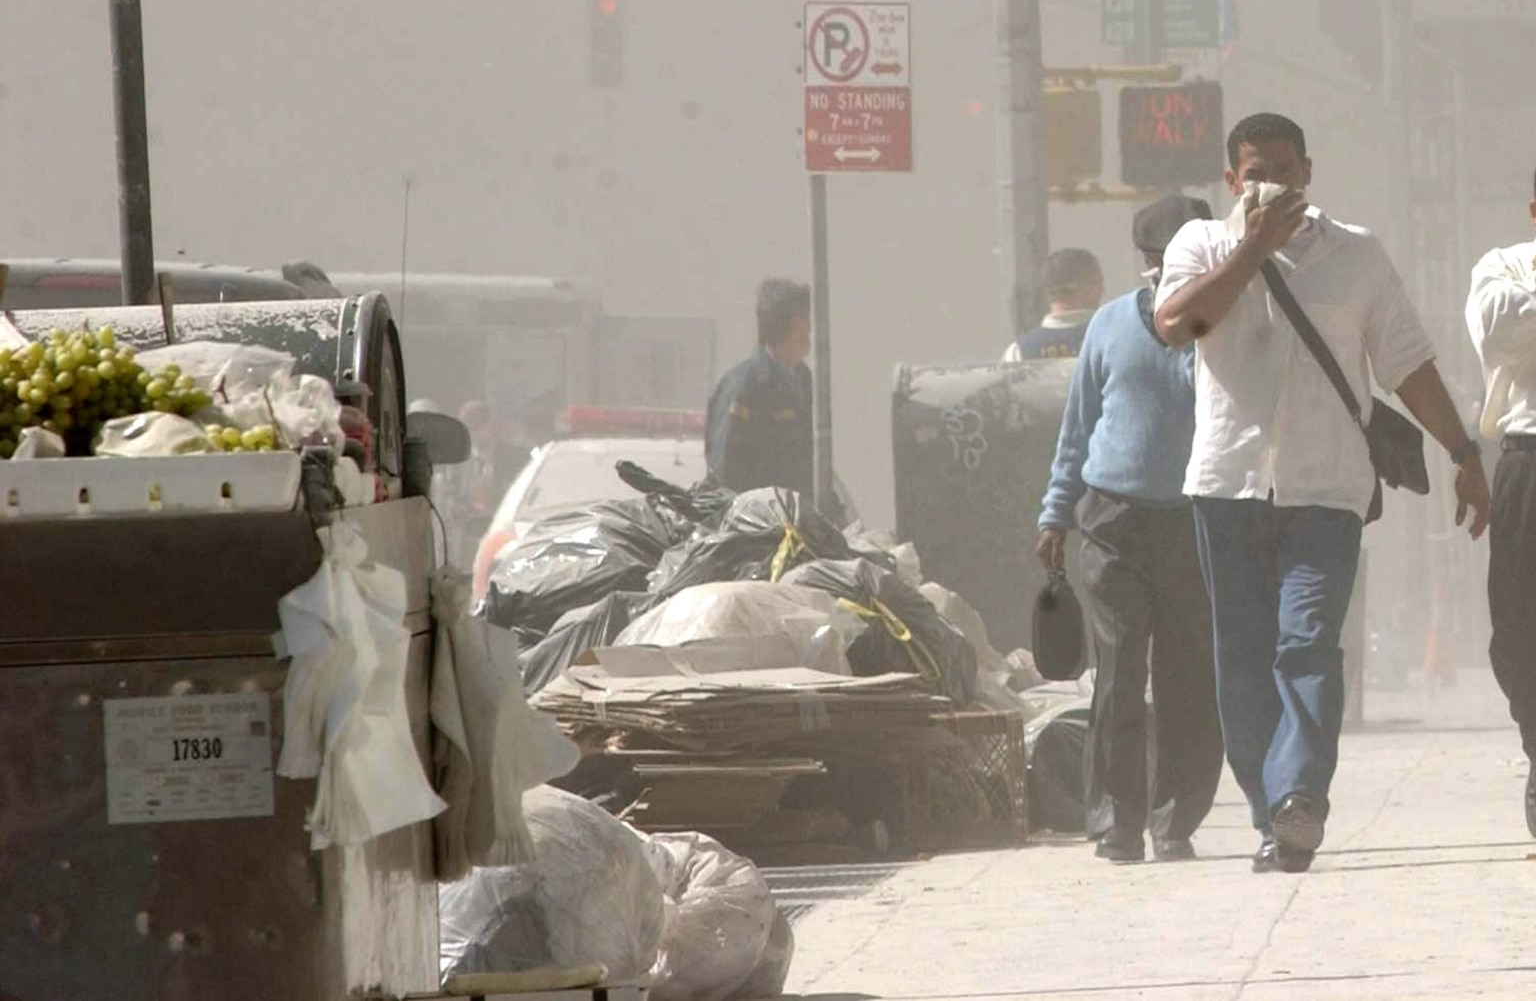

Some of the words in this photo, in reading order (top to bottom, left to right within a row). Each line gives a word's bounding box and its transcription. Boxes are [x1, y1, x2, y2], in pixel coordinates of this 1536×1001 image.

[811, 93, 828, 110] NO
[838, 91, 905, 111] STANDING
[172, 737, 224, 763] 17830
